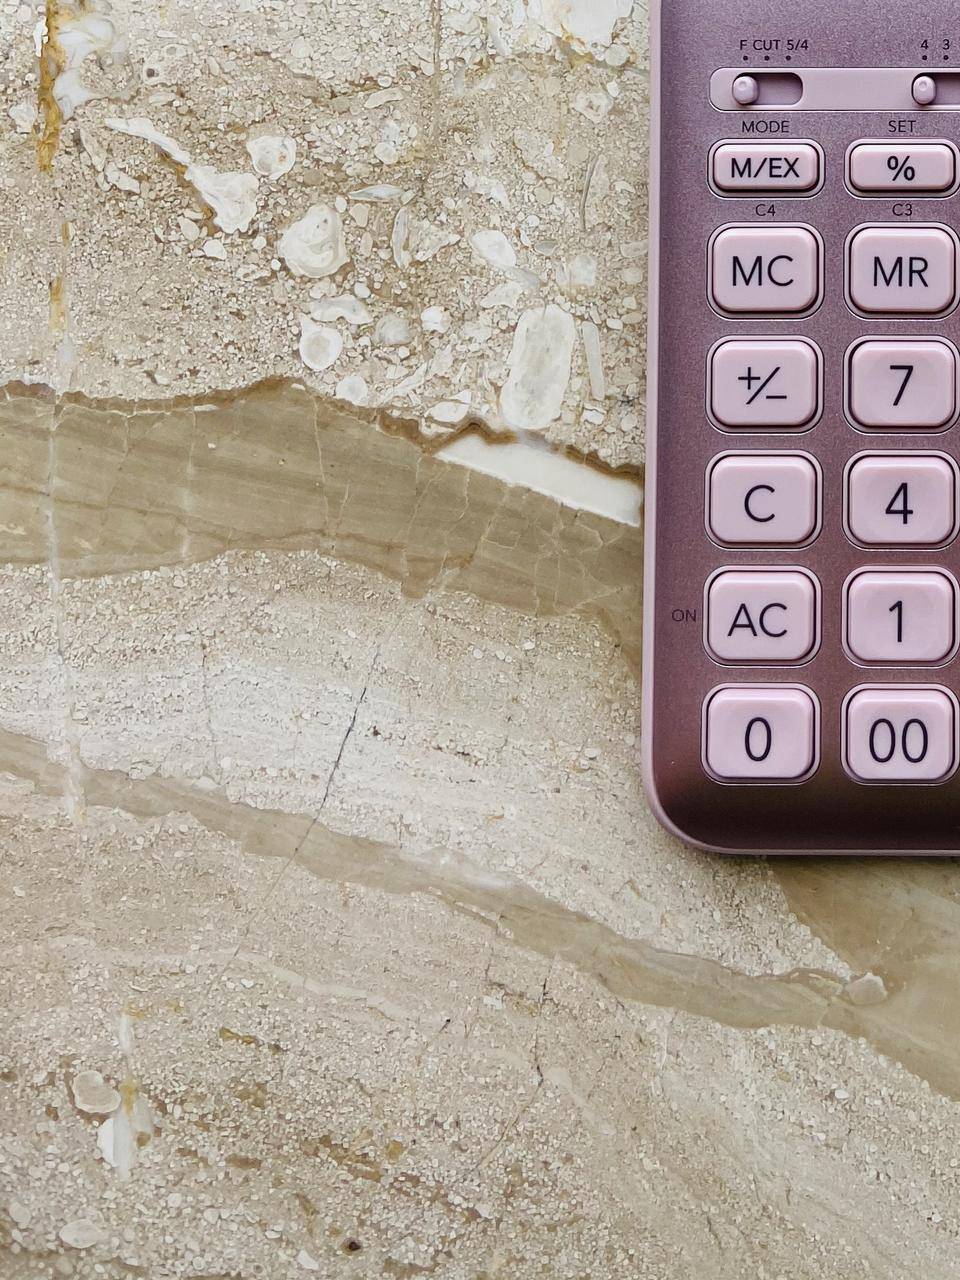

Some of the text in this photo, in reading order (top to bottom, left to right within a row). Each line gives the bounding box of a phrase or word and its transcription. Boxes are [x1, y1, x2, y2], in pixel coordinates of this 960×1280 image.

[740, 39, 809, 52] F CUT 5/4
[921, 39, 929, 50] 4
[942, 39, 951, 50] 3
[741, 120, 790, 133] MODE
[888, 120, 916, 133] SET
[731, 157, 800, 179] M/EX
[755, 204, 776, 217] C4
[892, 204, 913, 217] C3
[733, 255, 793, 286] MC
[874, 256, 928, 287] MR
[890, 365, 913, 406] 7
[744, 485, 775, 522] C
[886, 483, 913, 524] 4
[671, 608, 697, 622] ON
[728, 603, 787, 637] AC
[889, 601, 902, 642] 1
[745, 717, 771, 761] 0
[869, 719, 928, 763] 00
